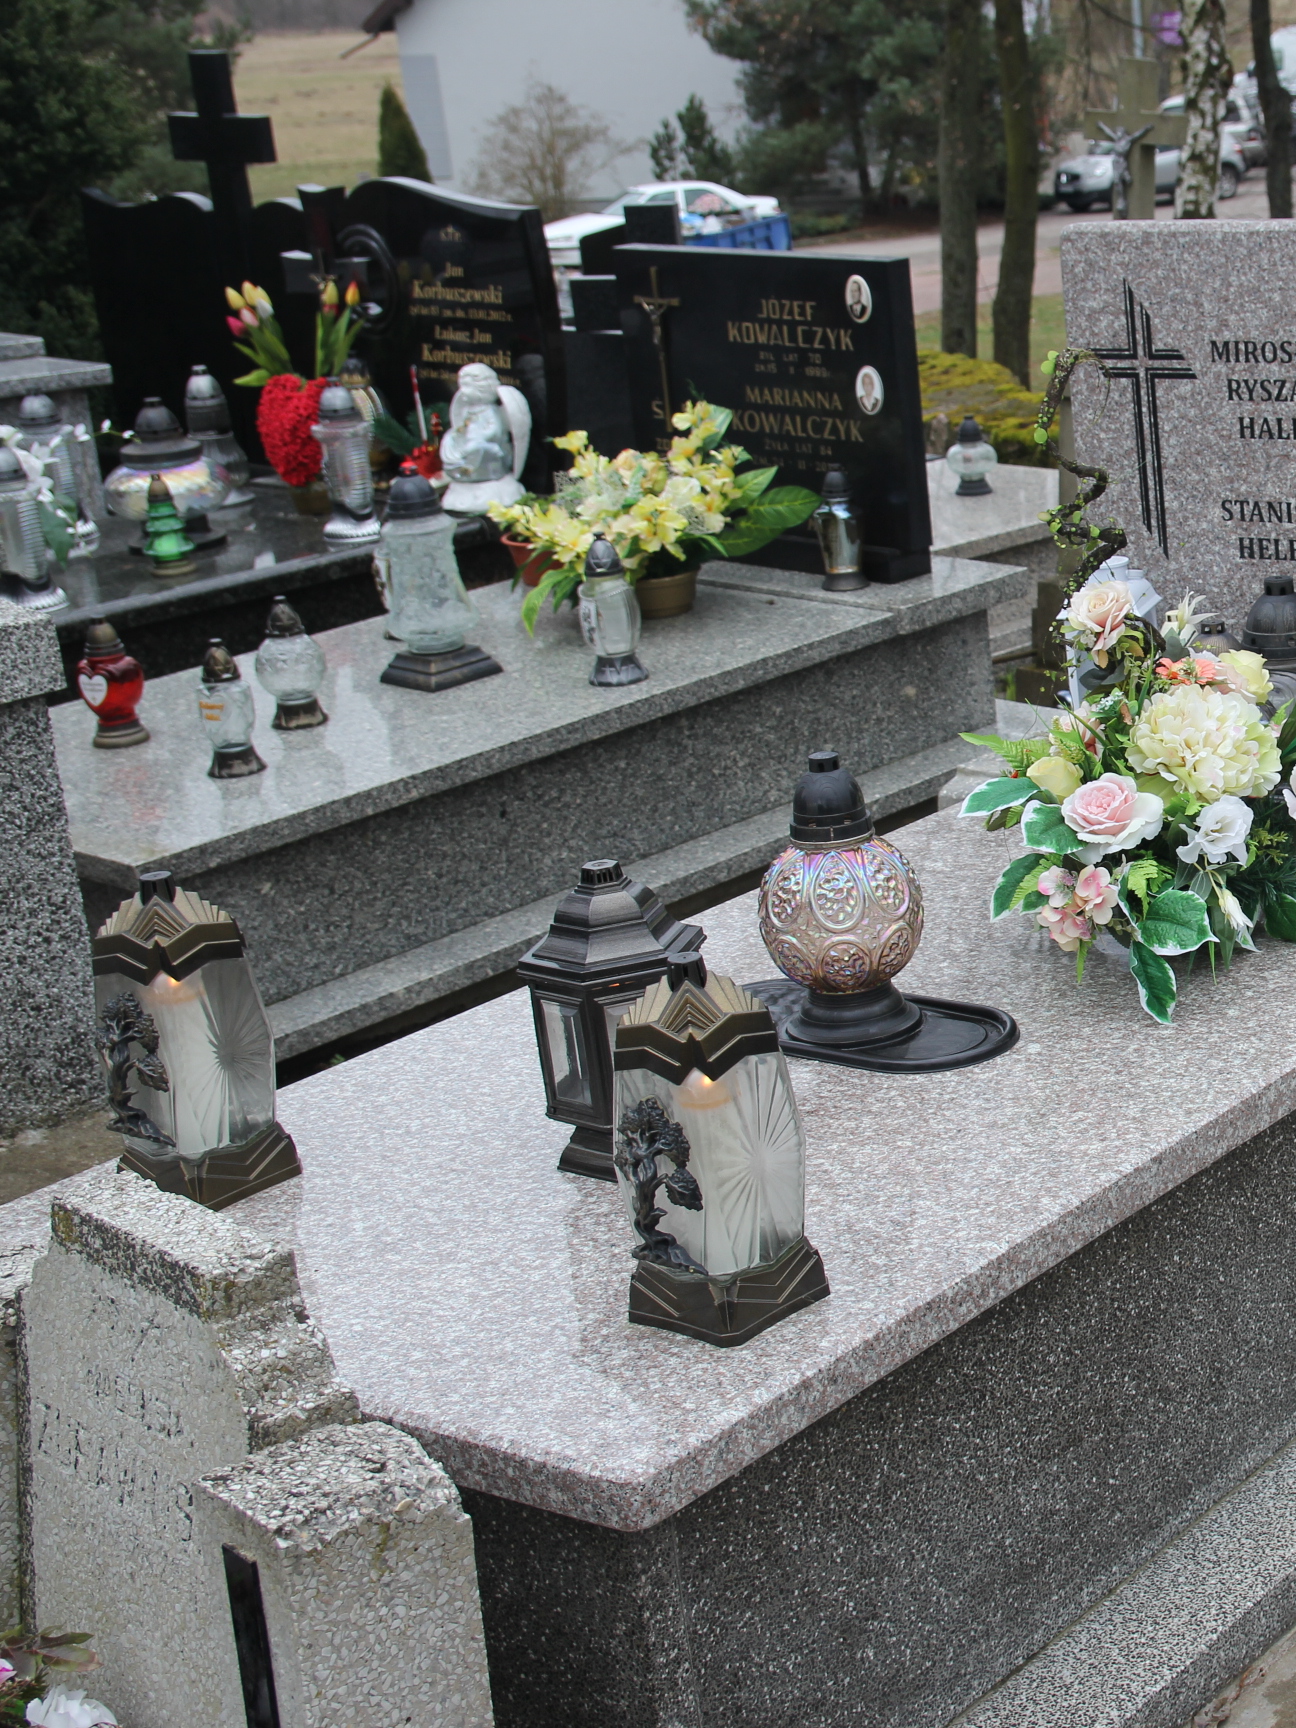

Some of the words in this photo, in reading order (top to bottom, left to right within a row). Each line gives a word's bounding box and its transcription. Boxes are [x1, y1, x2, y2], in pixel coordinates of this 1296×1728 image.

[757, 296, 816, 321] JÓZEF
[727, 320, 854, 350] KOWALCZYK
[745, 385, 843, 411] MARIANNA
[732, 408, 864, 442] KOWALCZYK
